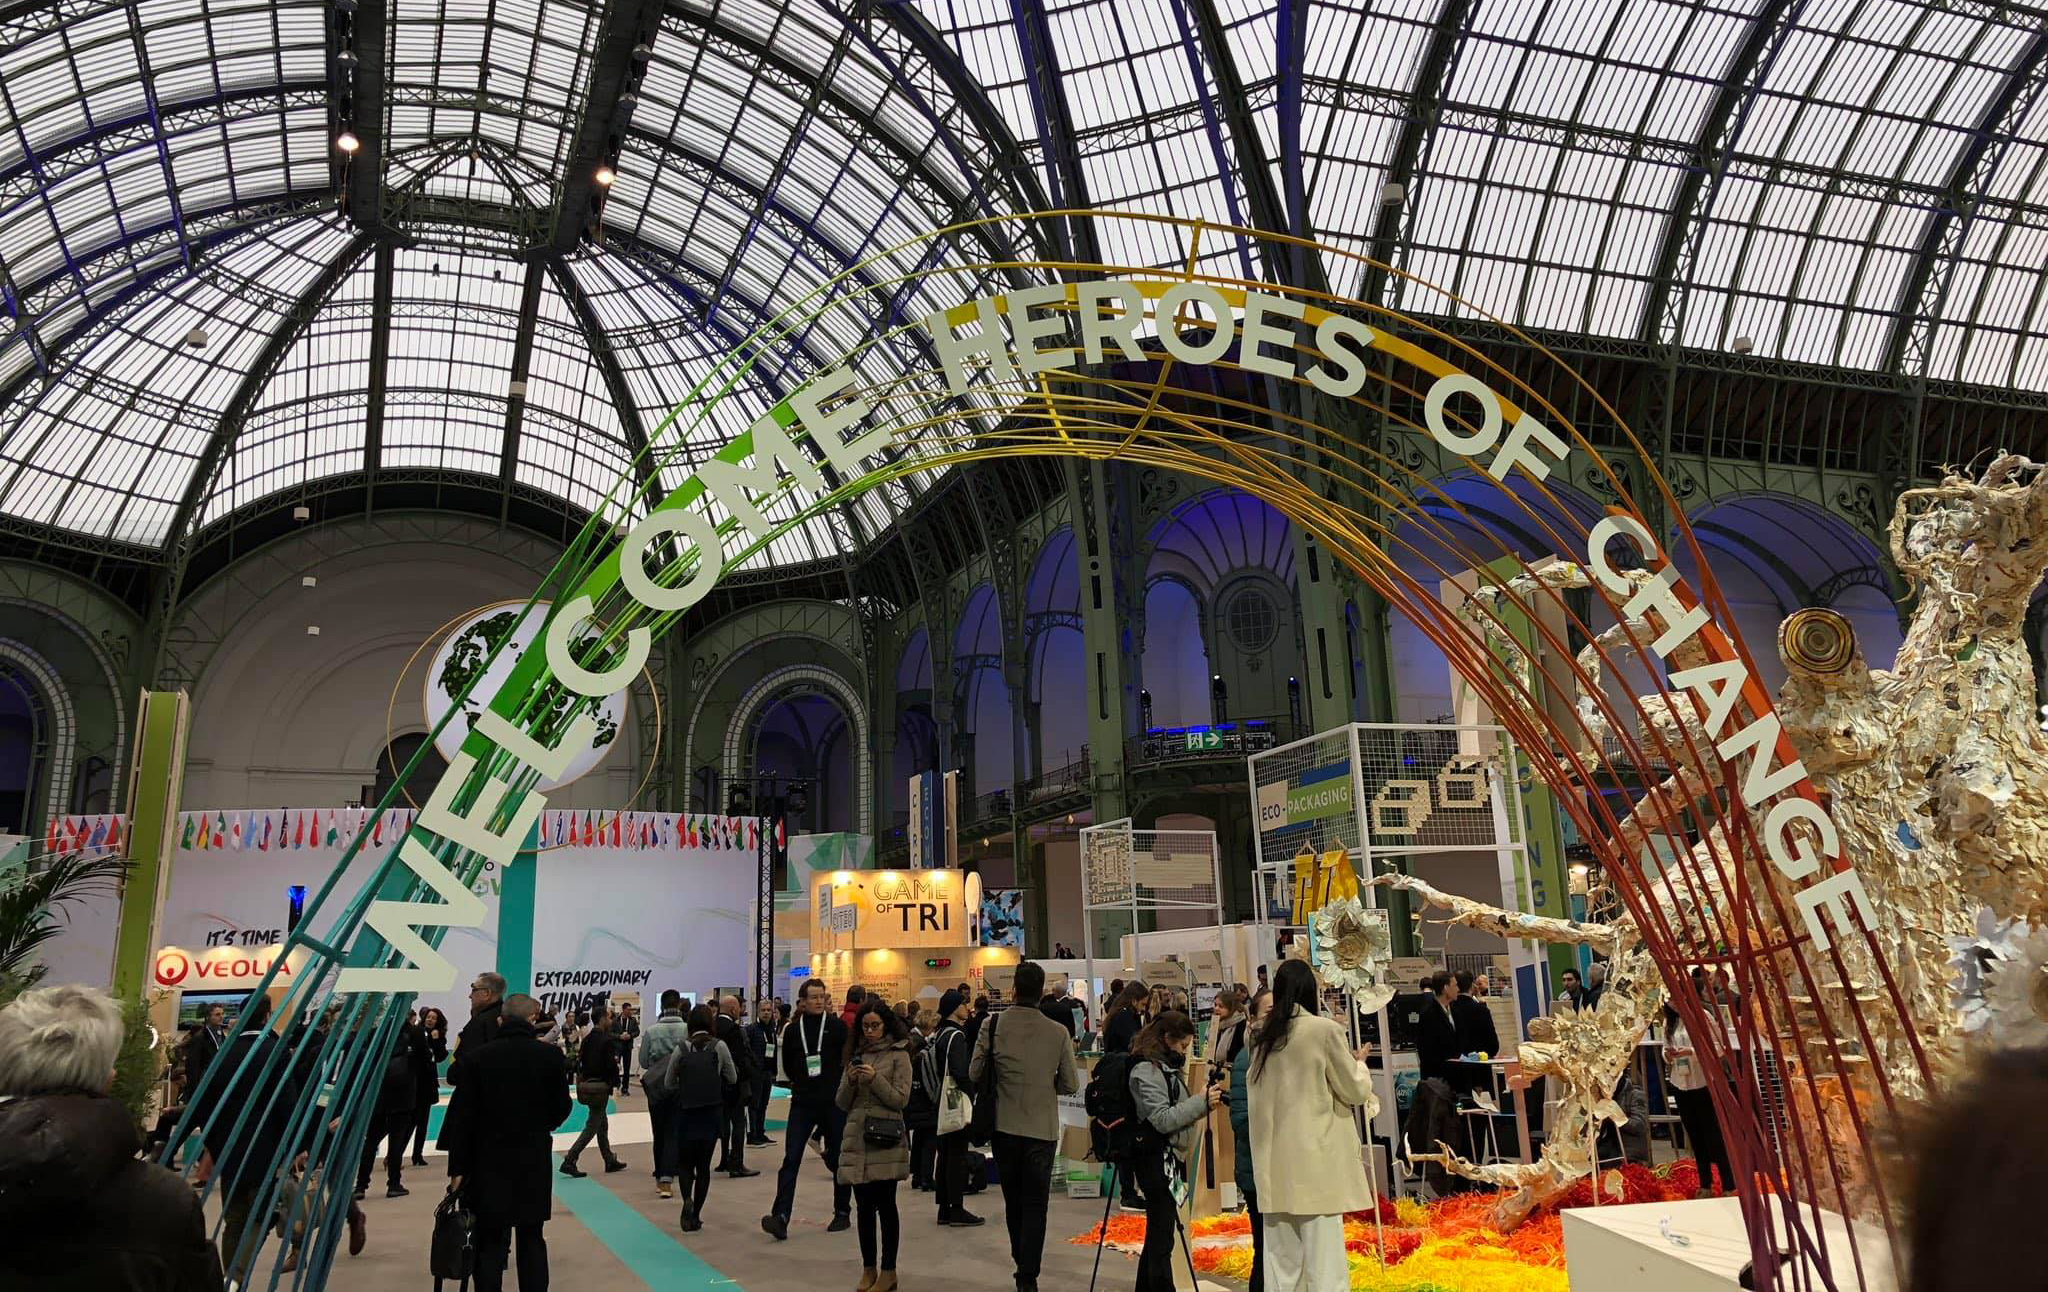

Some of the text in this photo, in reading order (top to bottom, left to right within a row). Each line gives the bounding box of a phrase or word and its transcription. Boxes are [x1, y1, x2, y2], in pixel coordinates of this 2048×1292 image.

[337, 280, 1879, 993] WELCOME HEROES OF CHANGE
[873, 879, 949, 901] GAME
[876, 902, 949, 932] OF TRI
[206, 929, 282, 947] IT'S TIME
[194, 958, 292, 979] VEOLIA
[534, 969, 652, 988] EXTRAORDINARY
[539, 990, 612, 1013] THING
